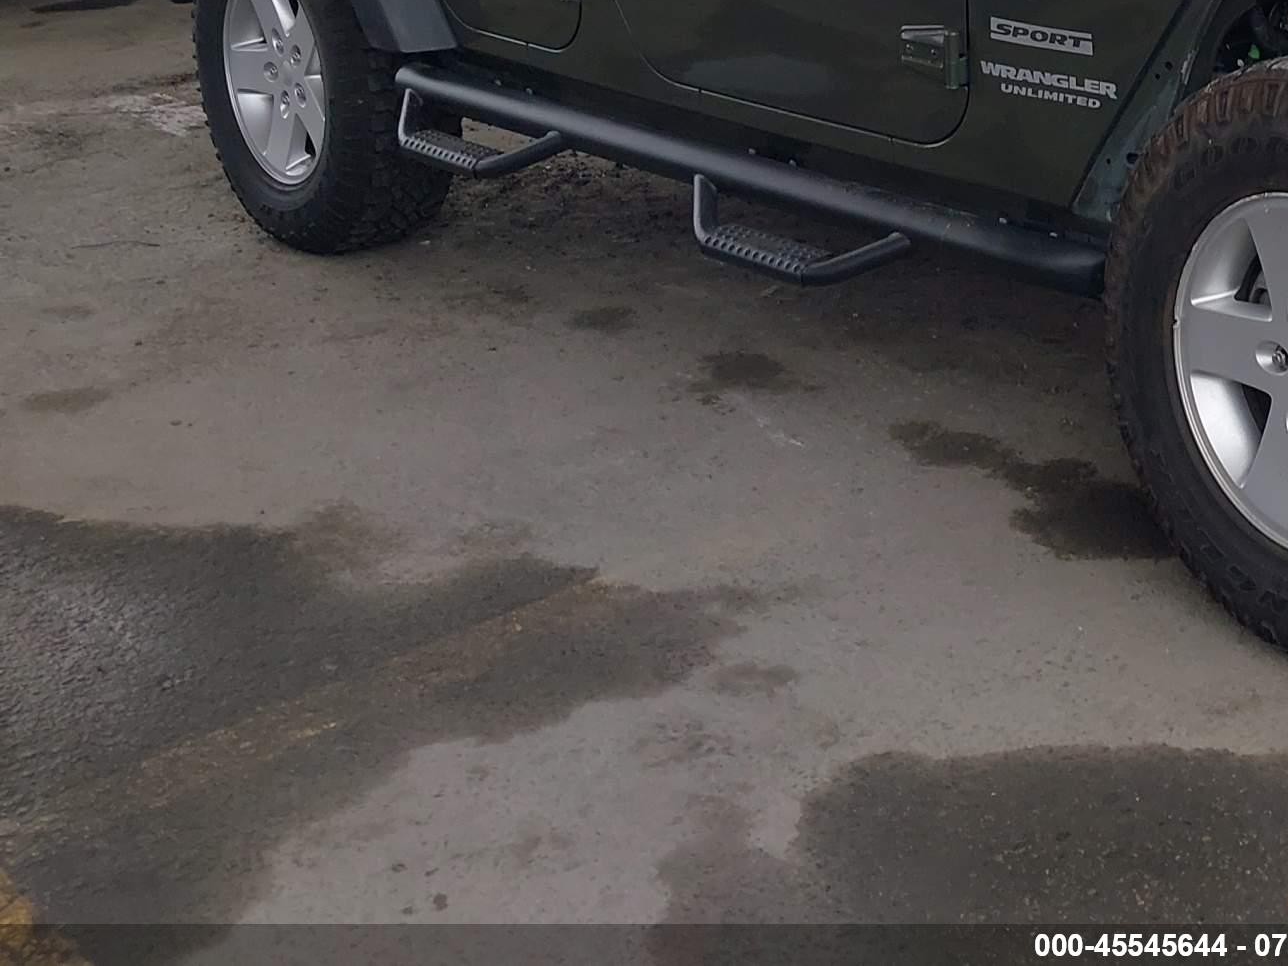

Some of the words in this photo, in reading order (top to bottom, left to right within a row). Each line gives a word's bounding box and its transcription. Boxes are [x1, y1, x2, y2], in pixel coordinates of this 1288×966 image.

[995, 23, 1084, 48] SPORT
[980, 60, 1118, 99] WRANGLER
[1000, 83, 1101, 109] UNLIMITED
